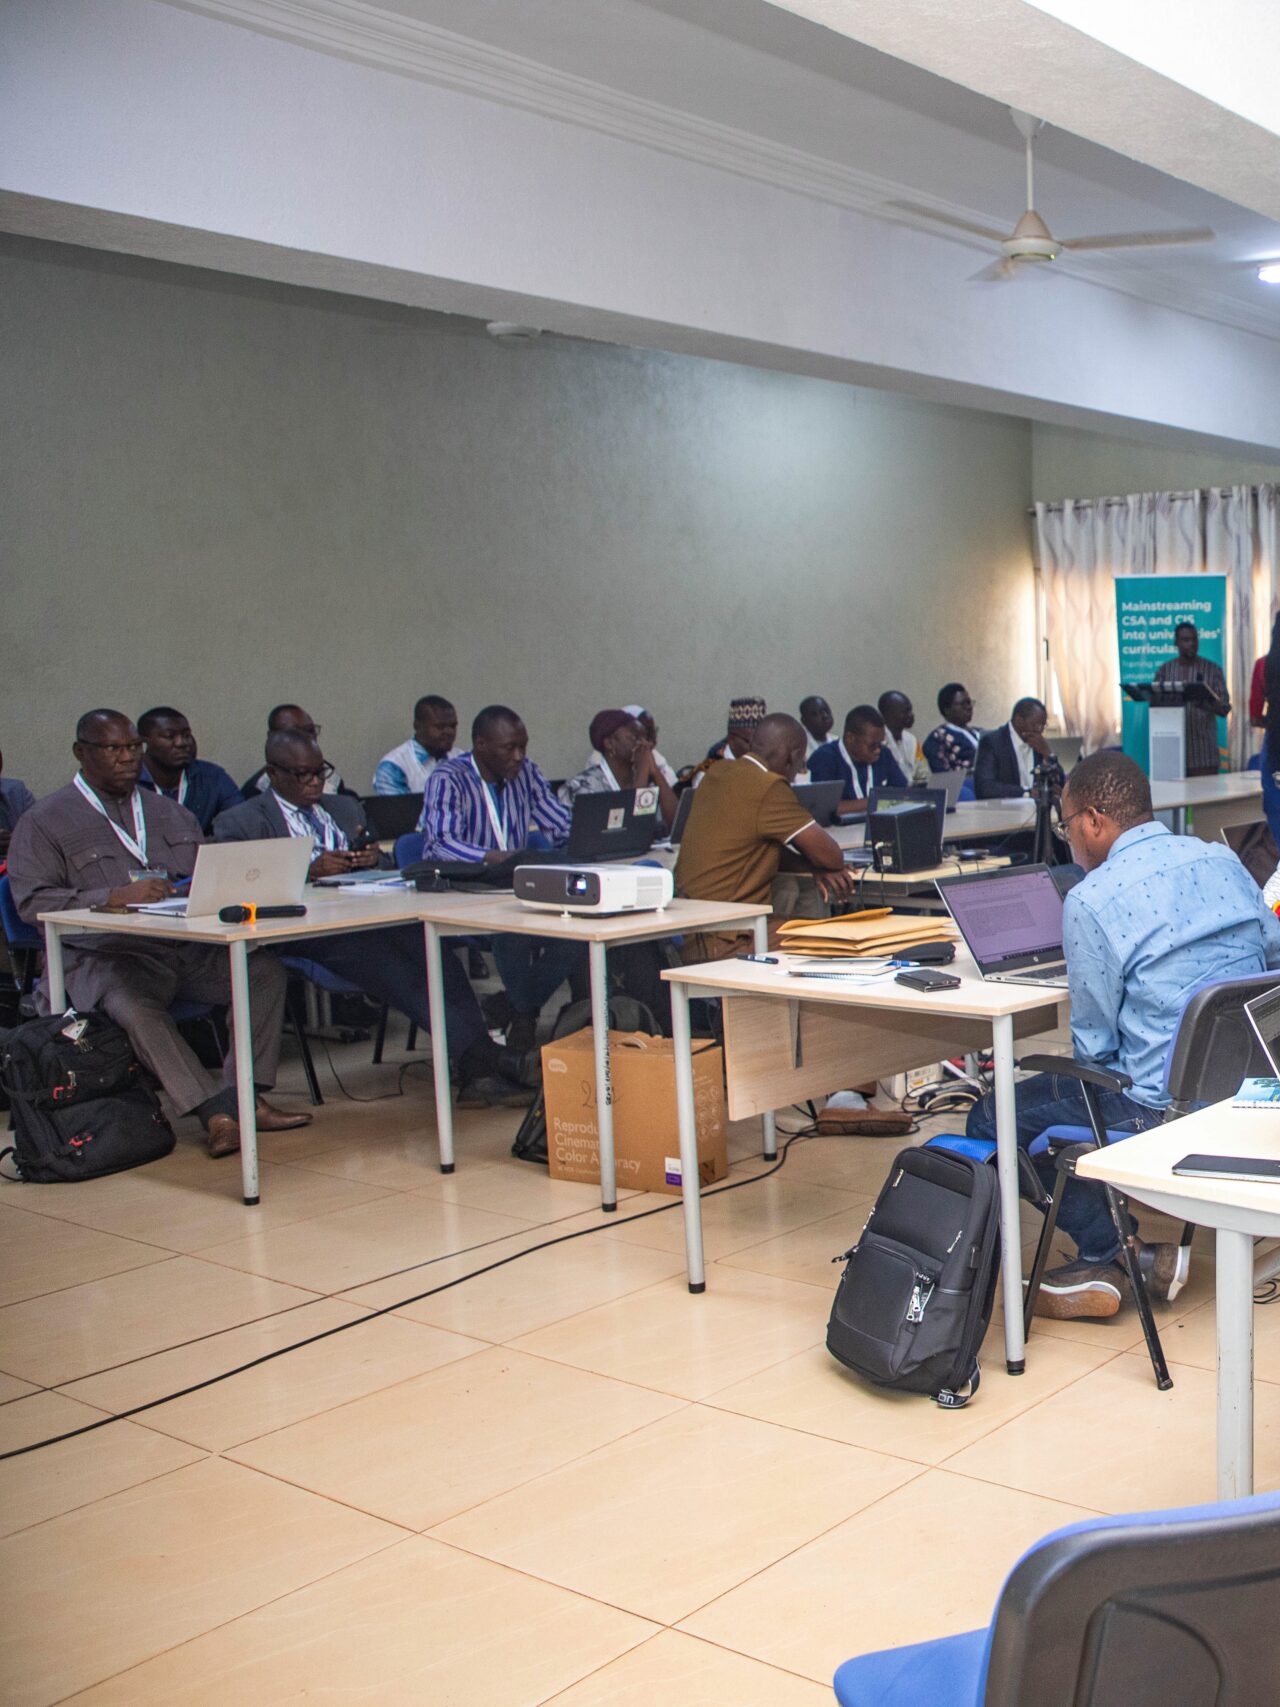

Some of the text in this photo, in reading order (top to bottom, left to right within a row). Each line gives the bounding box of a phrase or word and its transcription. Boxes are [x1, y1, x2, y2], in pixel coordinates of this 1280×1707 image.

[1121, 599, 1212, 613] Mainstreaming
[1121, 615, 1147, 626] CSA
[1148, 614, 1173, 626] and
[1121, 629, 1147, 640] into
[555, 1147, 588, 1163] Color
